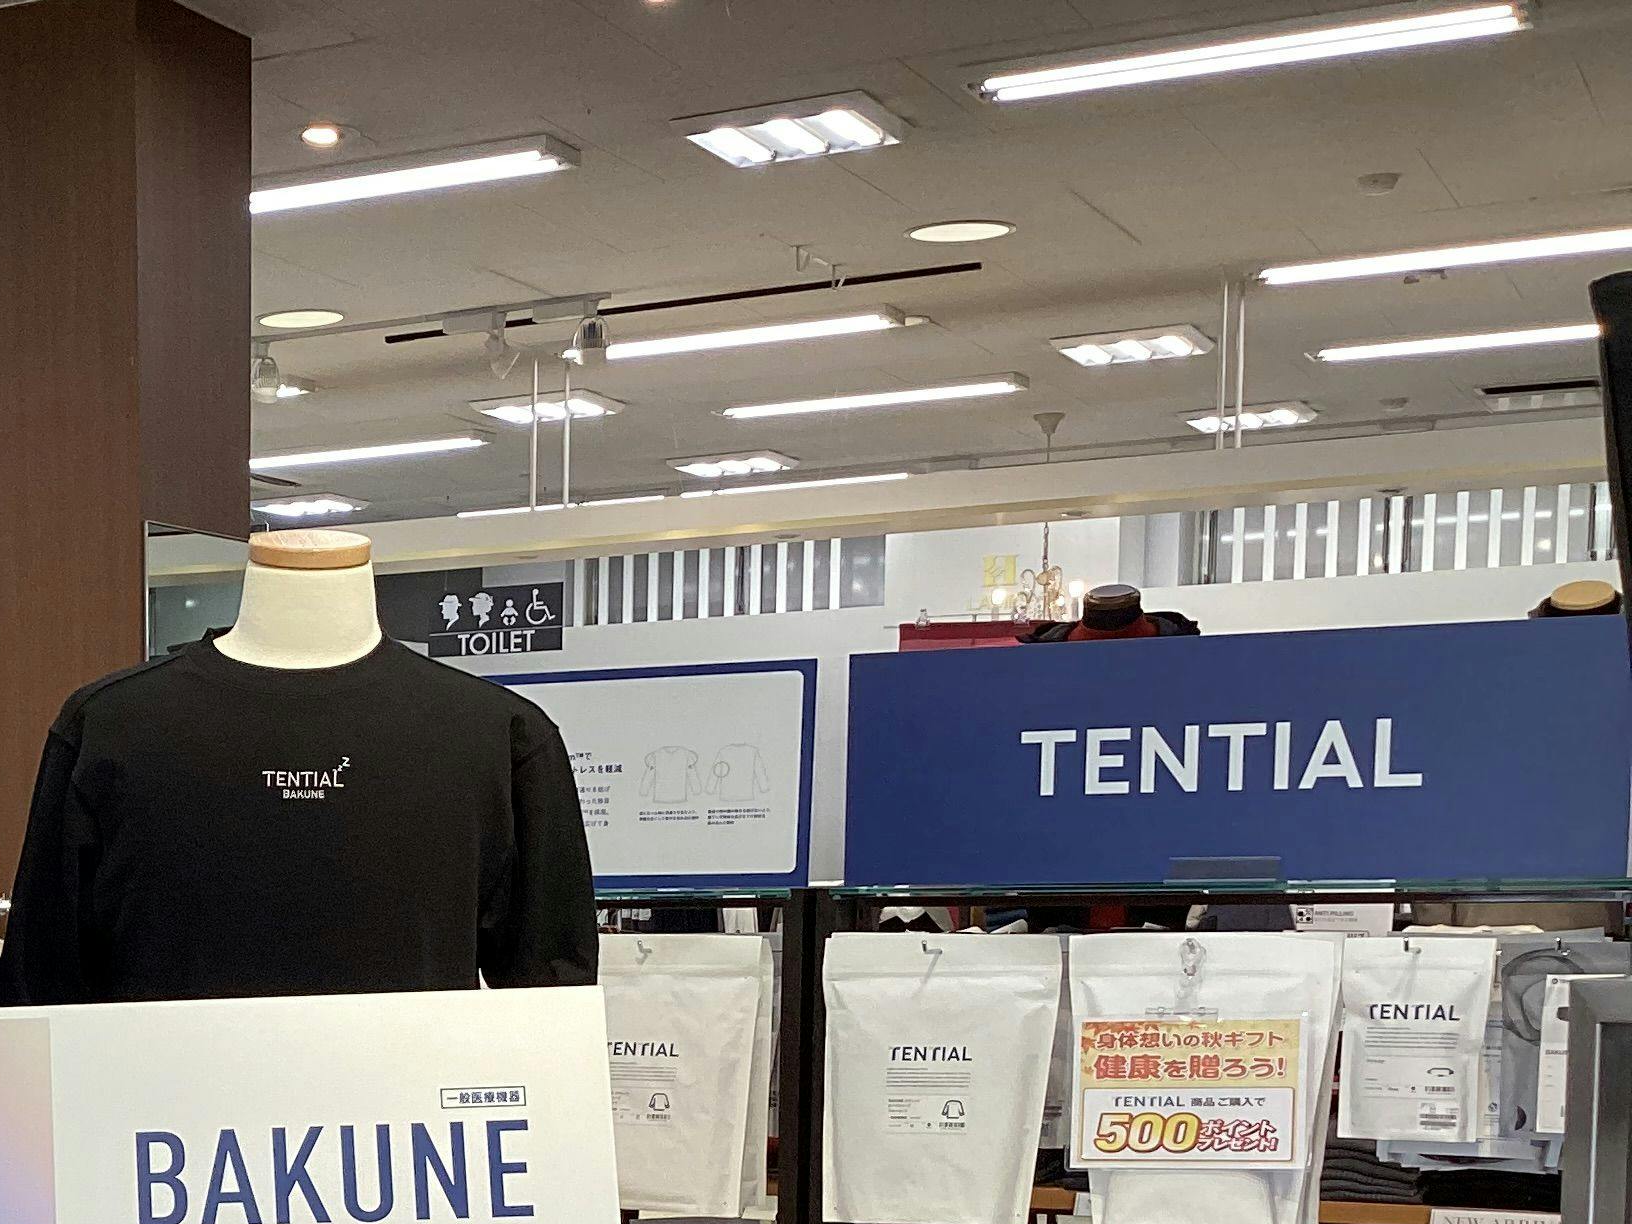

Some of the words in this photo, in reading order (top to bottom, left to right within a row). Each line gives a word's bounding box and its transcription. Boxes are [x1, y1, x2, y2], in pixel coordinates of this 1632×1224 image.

[457, 630, 535, 655] TOILET
[1020, 718, 1424, 797] TENTIAL
[262, 770, 344, 787] TENTIAL
[282, 789, 325, 799] BAKUNE
[1369, 1003, 1461, 1021] TENTIAL
[1096, 1031, 1283, 1049] 身体想いの秋ギフト
[889, 1046, 972, 1062] TENTIAL
[1113, 1096, 1185, 1107] TENTIAL
[1093, 1112, 1201, 1153] 500
[1199, 1118, 1277, 1136] ポイント
